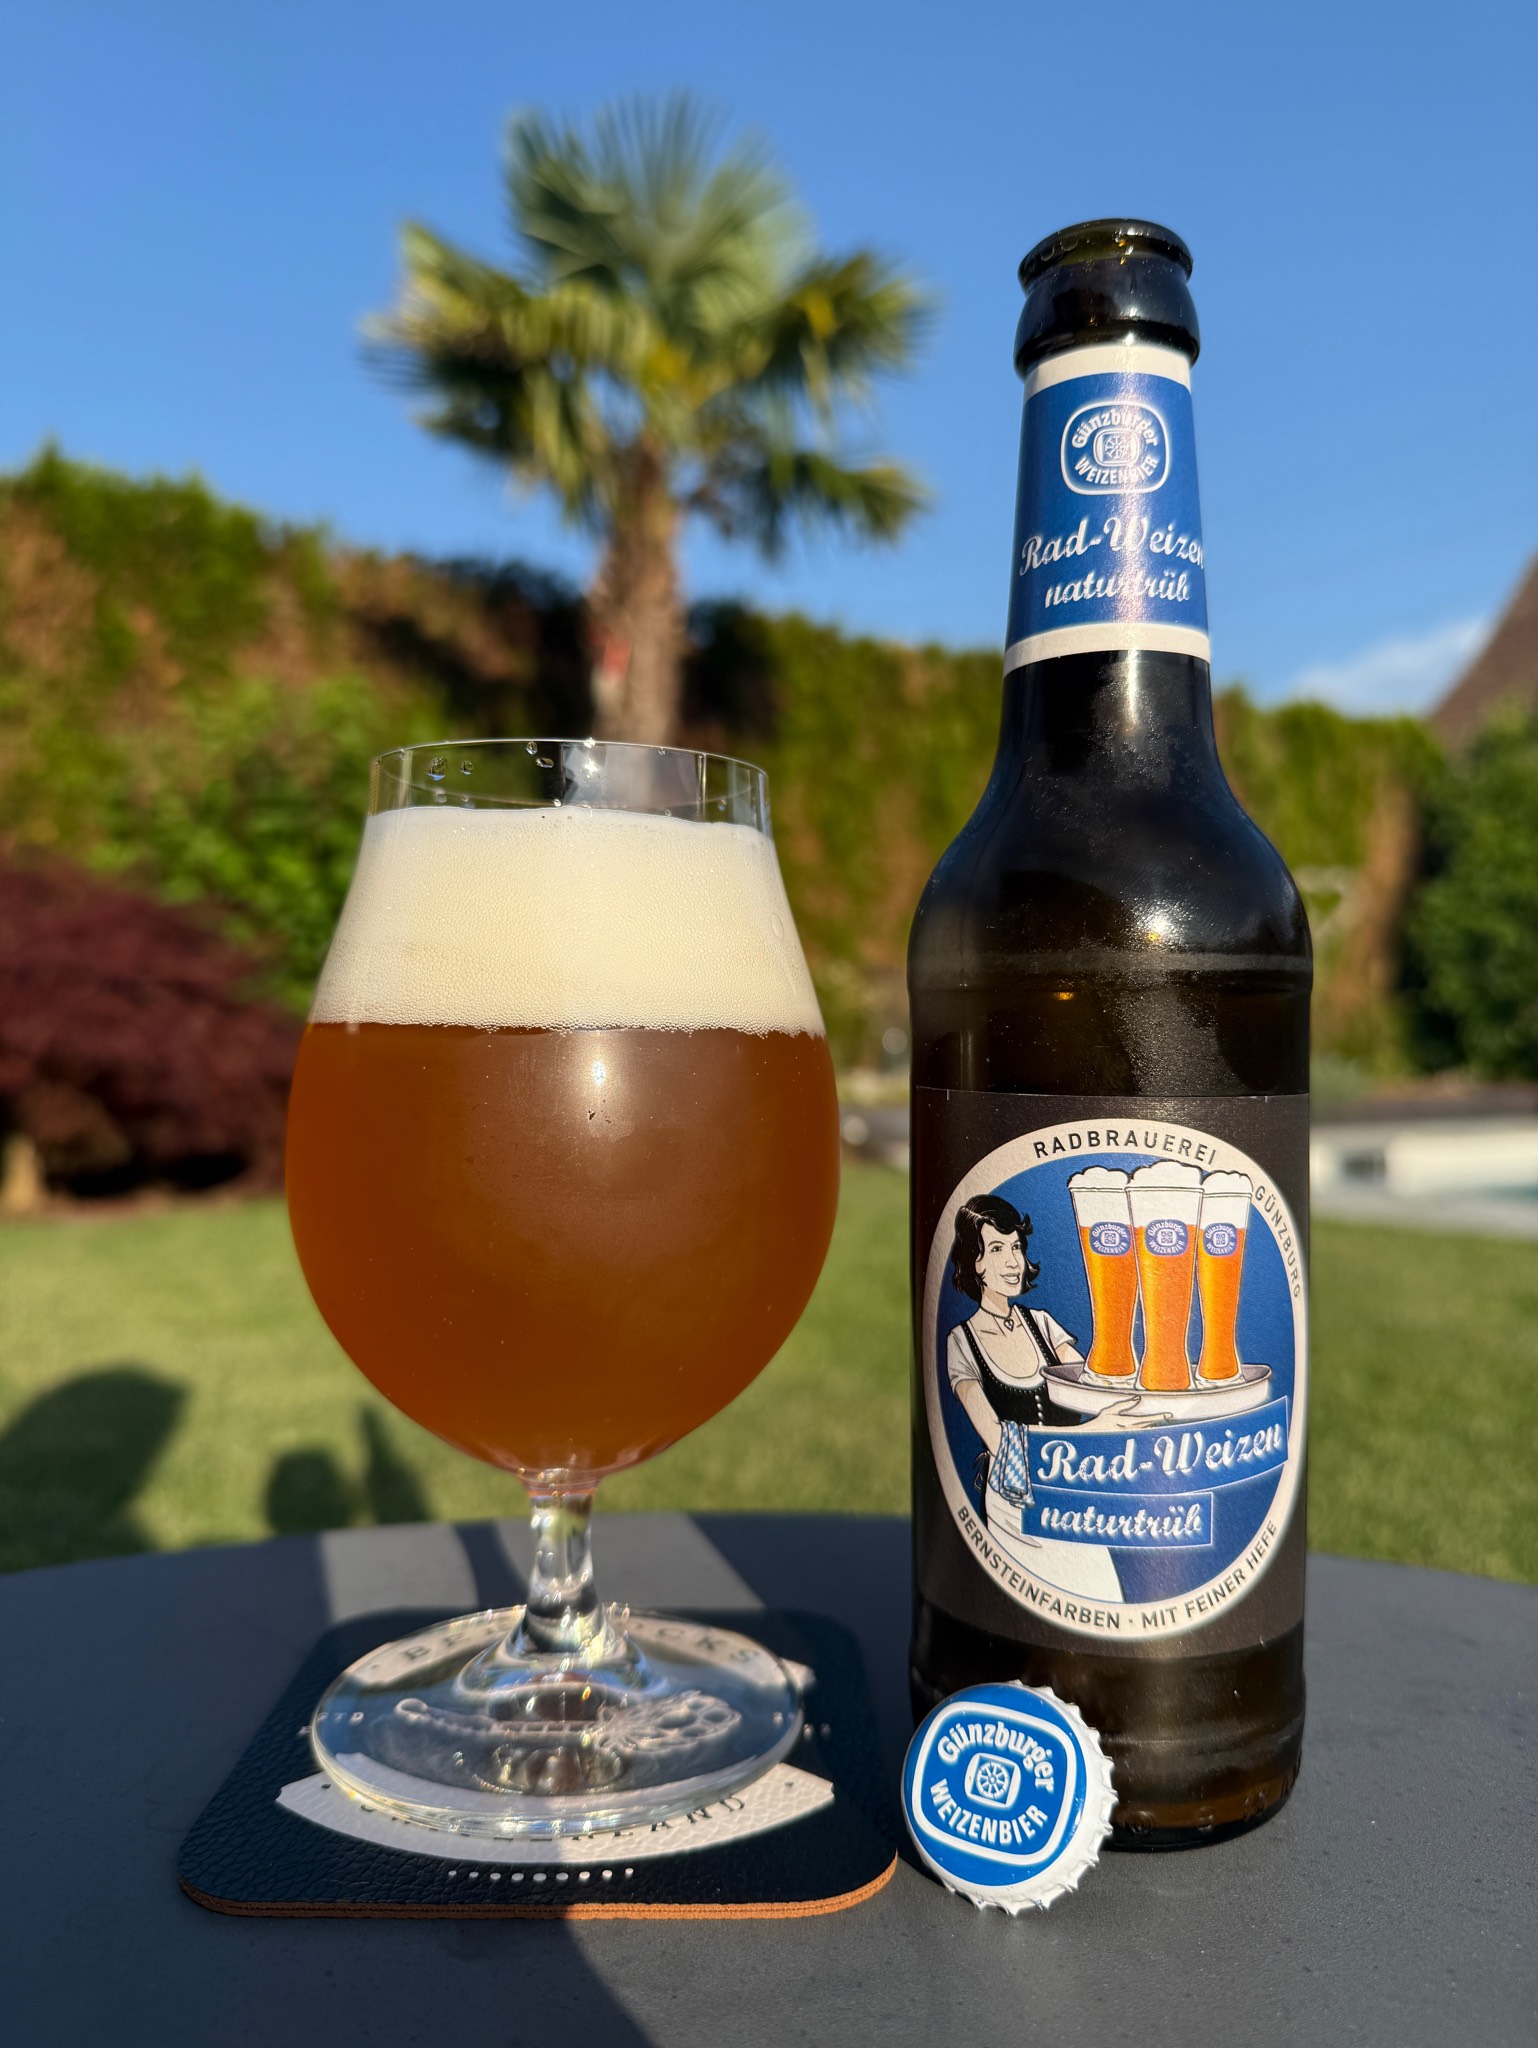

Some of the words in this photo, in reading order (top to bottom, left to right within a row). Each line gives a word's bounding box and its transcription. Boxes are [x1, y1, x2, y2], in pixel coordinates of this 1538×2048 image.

[1071, 408, 1159, 449] Günzburger
[1074, 456, 1160, 485] WEIZENBIER
[1044, 569, 1191, 609] naturtrüb
[1033, 1129, 1217, 1166] RADBRAUEREI
[1255, 1184, 1302, 1300] GÜNZBURG
[1036, 1421, 1284, 1483] Rad-Weizen
[1040, 1502, 1203, 1538] naturtrüb
[956, 1504, 1122, 1630] BERNSTEINFARBEN
[1141, 1607, 1179, 1630] MIT
[1184, 1568, 1247, 1620] FEINER
[1248, 1520, 1280, 1574] HEFE
[937, 1721, 1056, 1795] Günzburger
[930, 1778, 1050, 1845] WEIZENBIER
